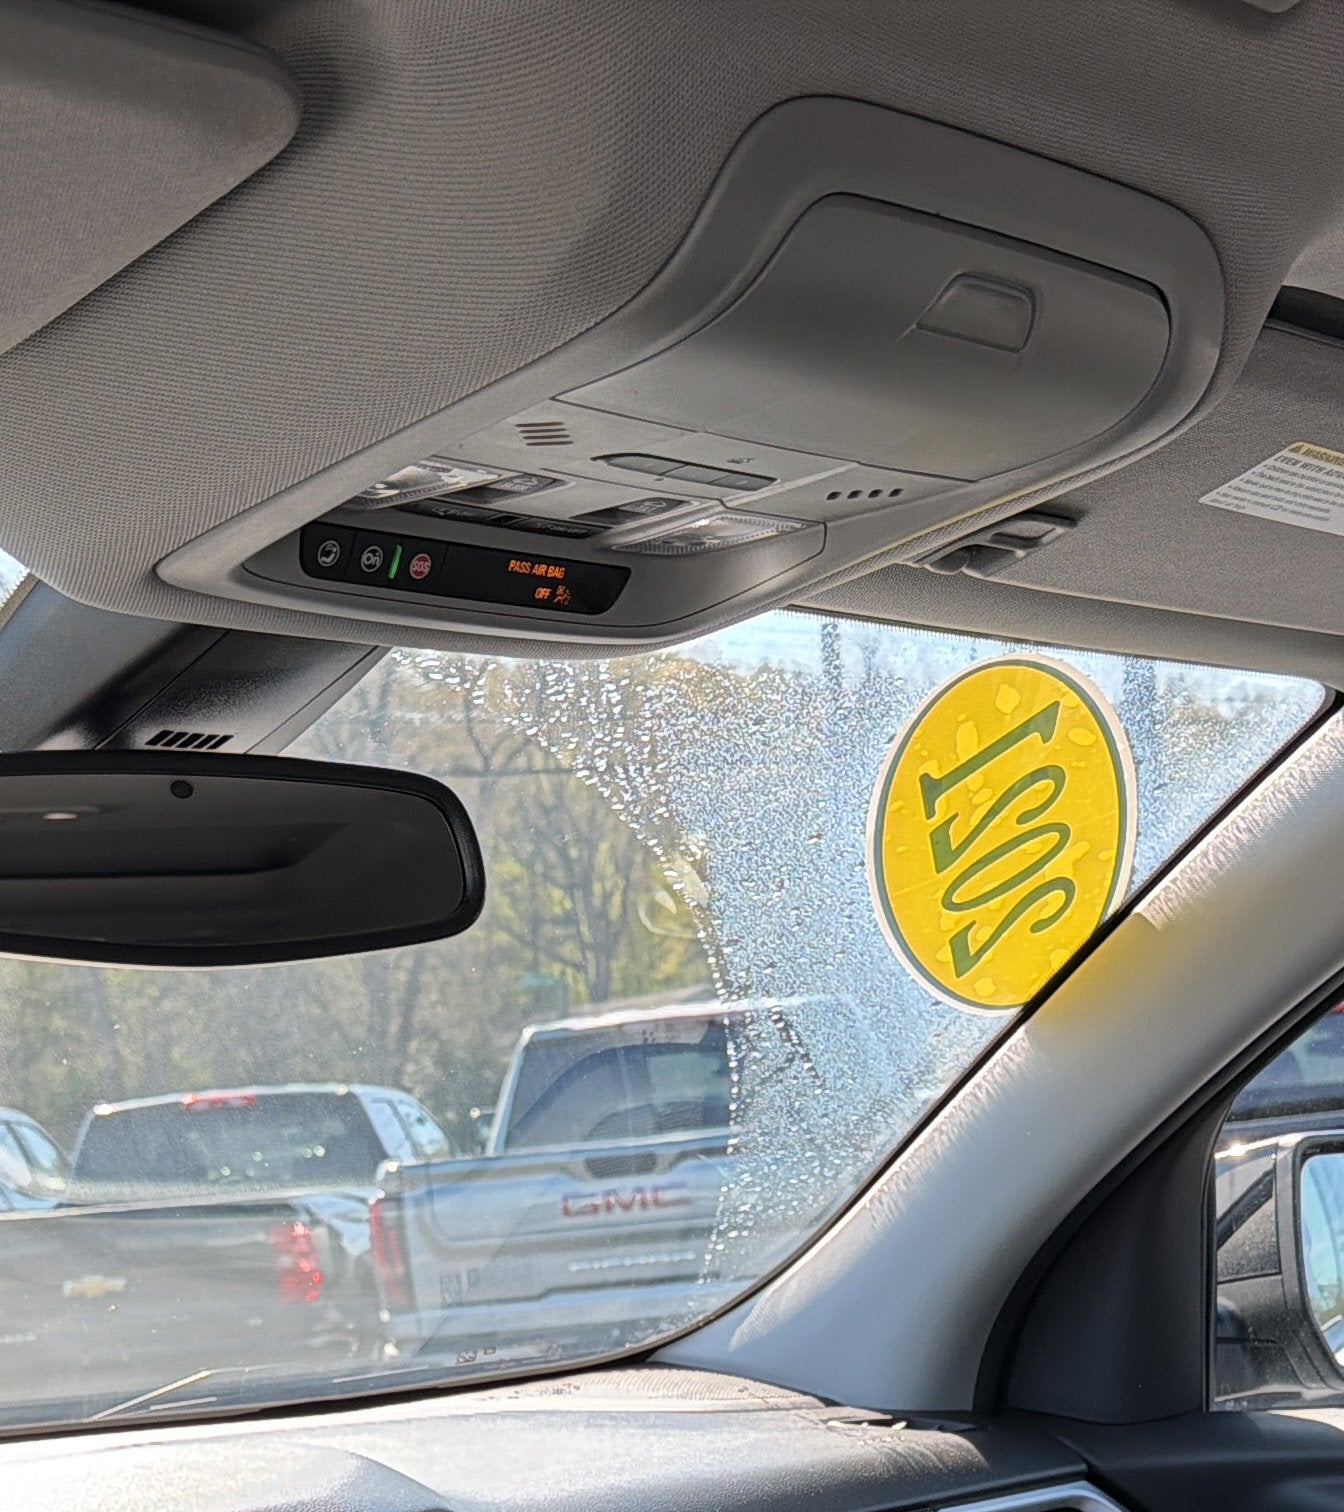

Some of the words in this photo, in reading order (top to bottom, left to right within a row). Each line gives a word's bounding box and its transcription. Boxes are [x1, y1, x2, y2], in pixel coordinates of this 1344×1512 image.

[1274, 455, 1299, 467] EVEN
[1299, 461, 1327, 474] WITH
[411, 560, 431, 573] SOS
[508, 559, 532, 575] PASS
[532, 563, 548, 577] AIR
[548, 566, 566, 579] BAG
[534, 587, 552, 600] OFF
[561, 1181, 692, 1217] GMC
